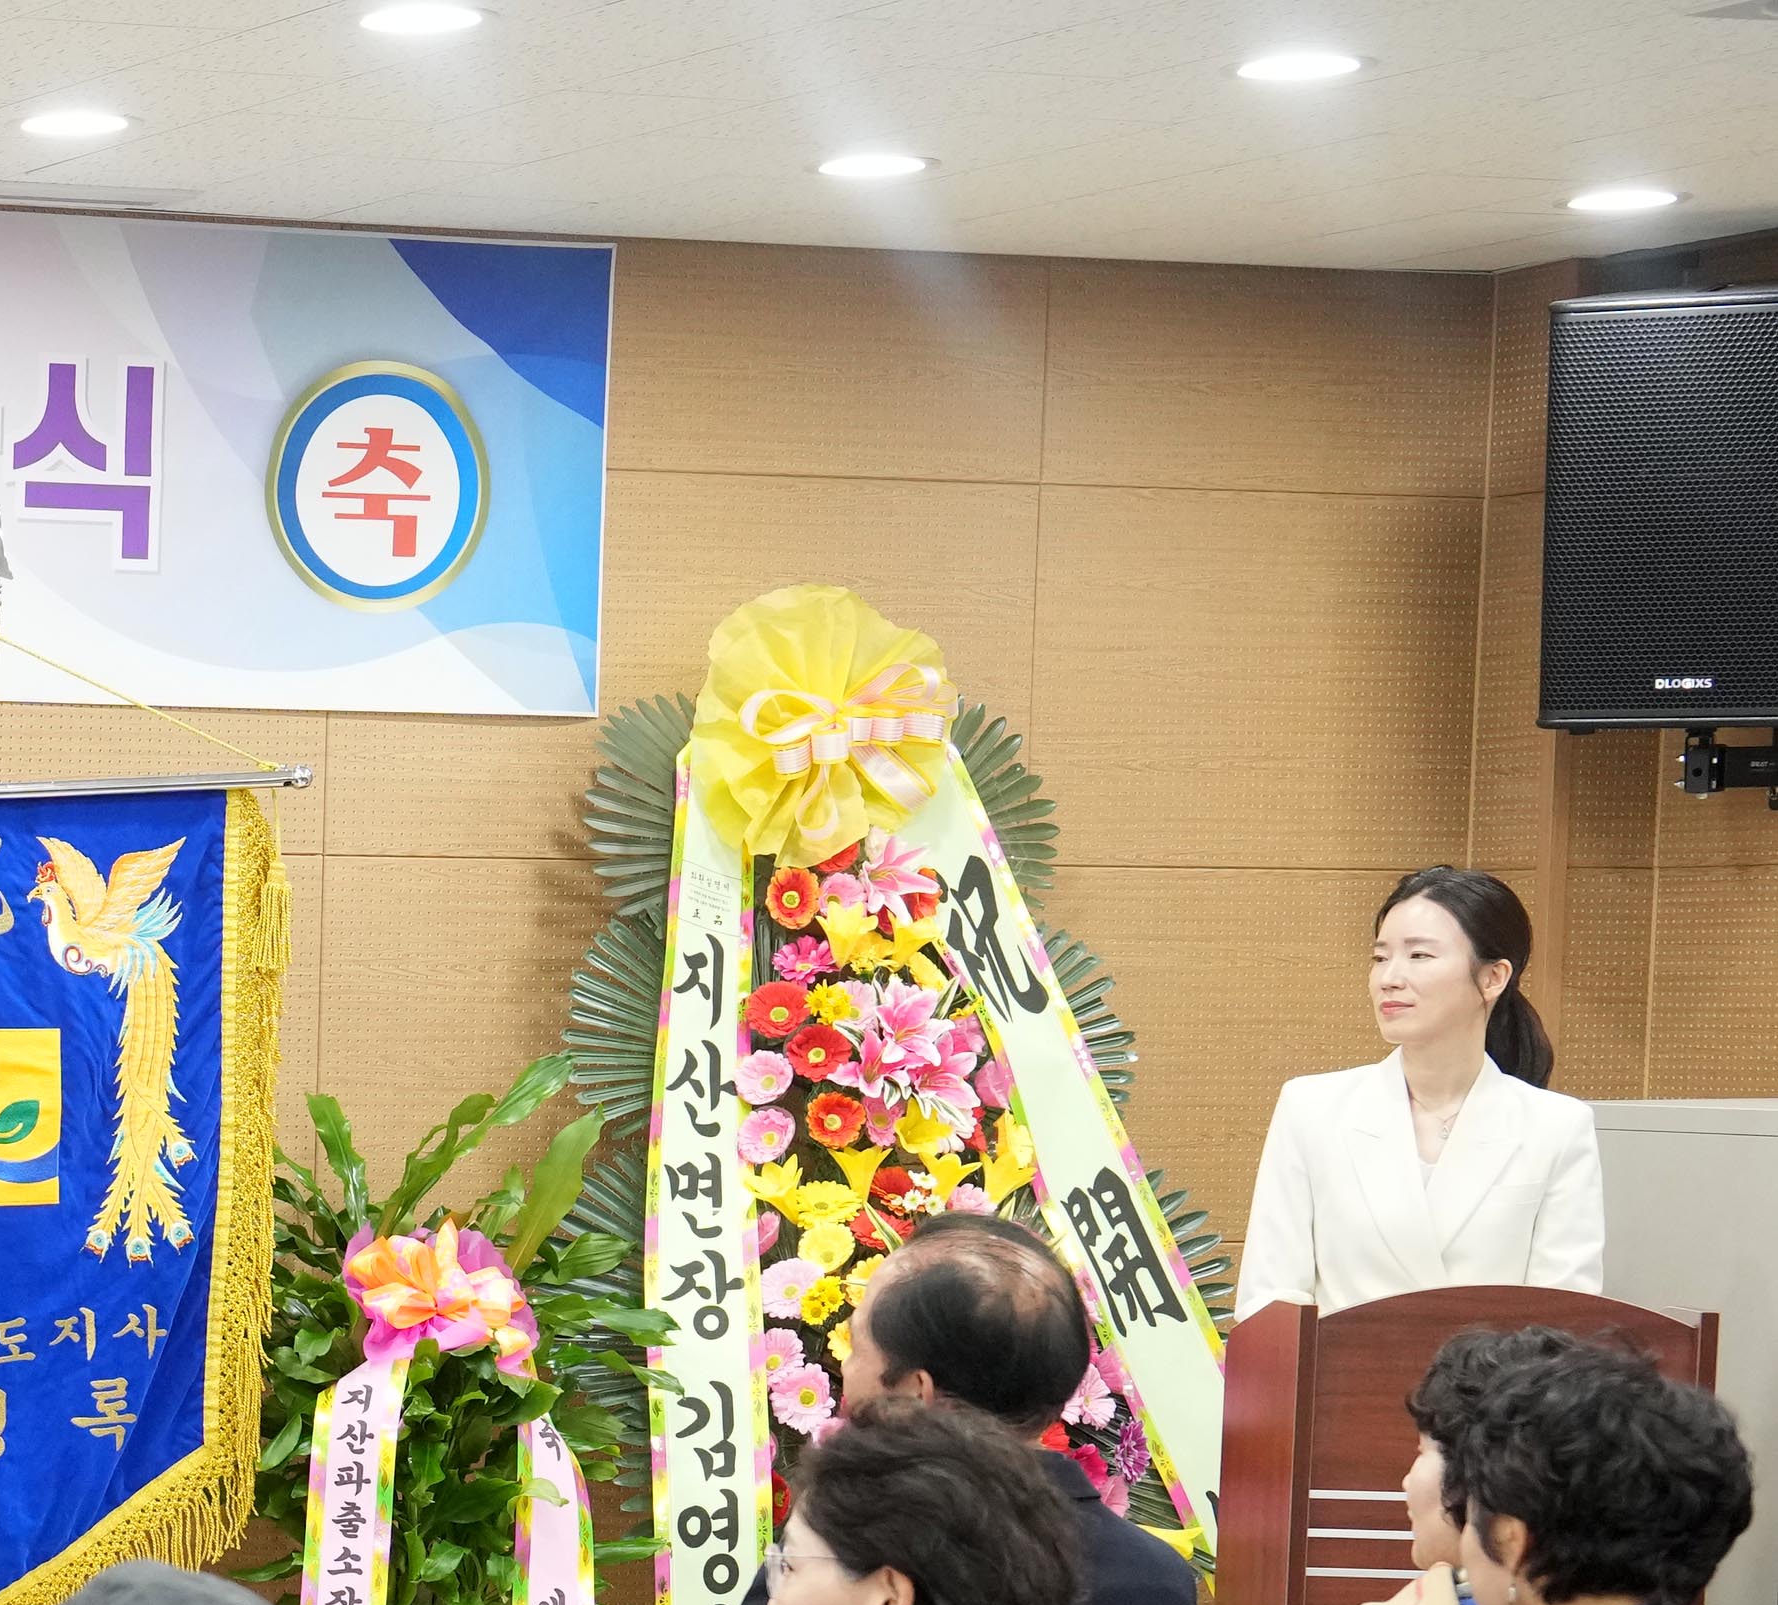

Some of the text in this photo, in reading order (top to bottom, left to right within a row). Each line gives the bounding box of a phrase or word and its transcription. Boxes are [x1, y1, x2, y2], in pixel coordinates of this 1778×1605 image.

[322, 427, 430, 558] 축
[1655, 678, 1714, 690] DLOGIXS
[660, 931, 746, 1342] 지산면장
[941, 854, 1189, 1339] 祝 開
